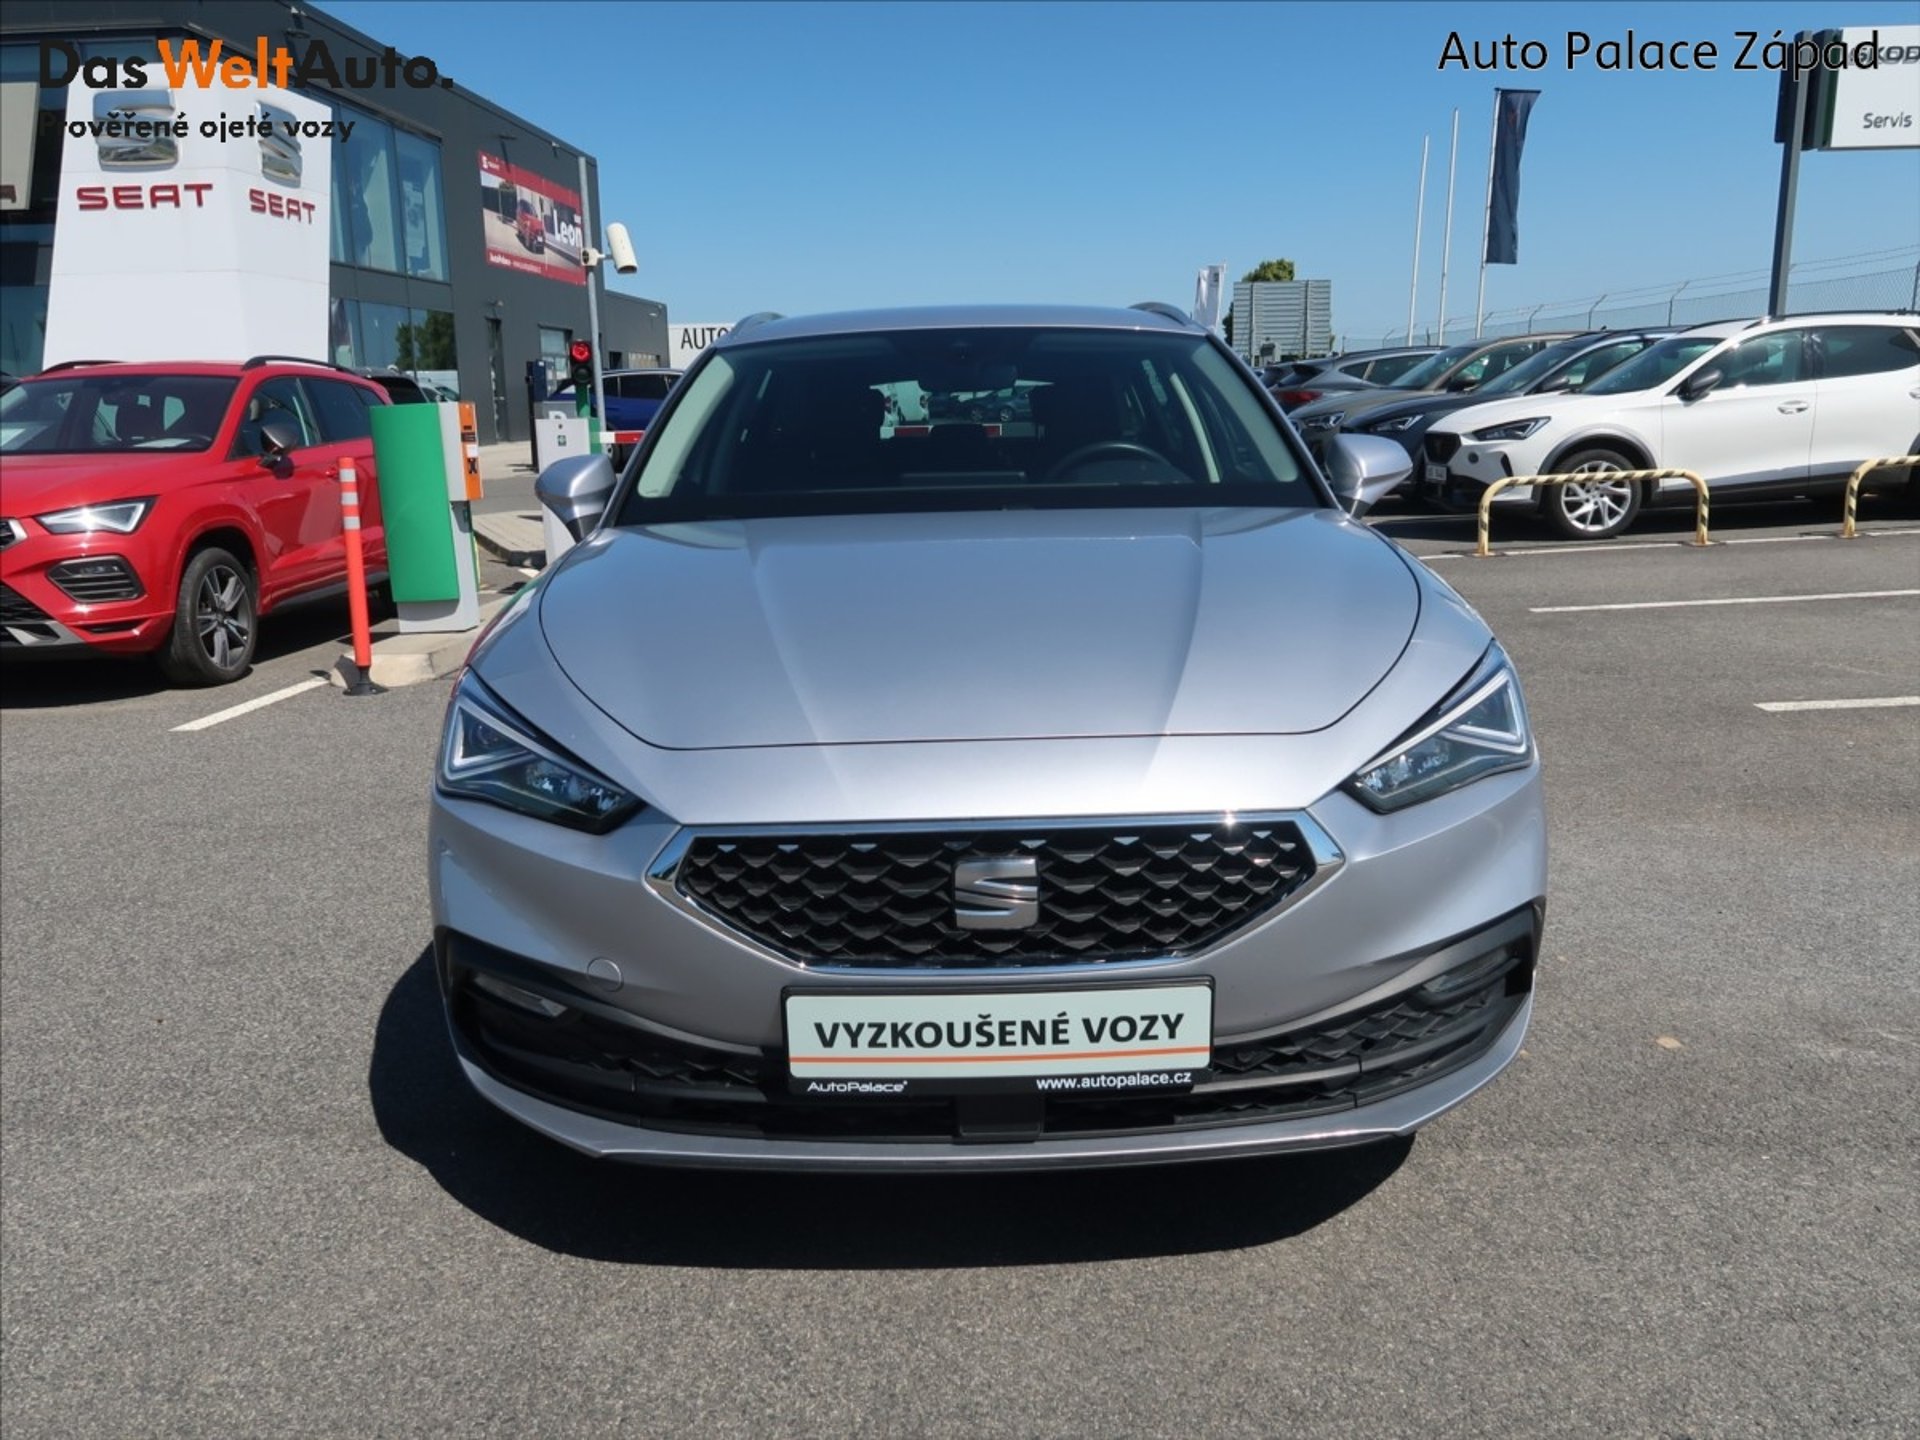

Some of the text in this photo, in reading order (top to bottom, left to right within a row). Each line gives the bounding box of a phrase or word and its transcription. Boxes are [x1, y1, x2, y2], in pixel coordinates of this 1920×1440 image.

[1863, 111, 1913, 129] Servis
[76, 183, 213, 211] SEAT
[249, 188, 316, 225] SEAT
[813, 1011, 1185, 1050] VYZKOUŠENÉ VOZY
[1036, 1071, 1192, 1090] www.autopalace.cz
